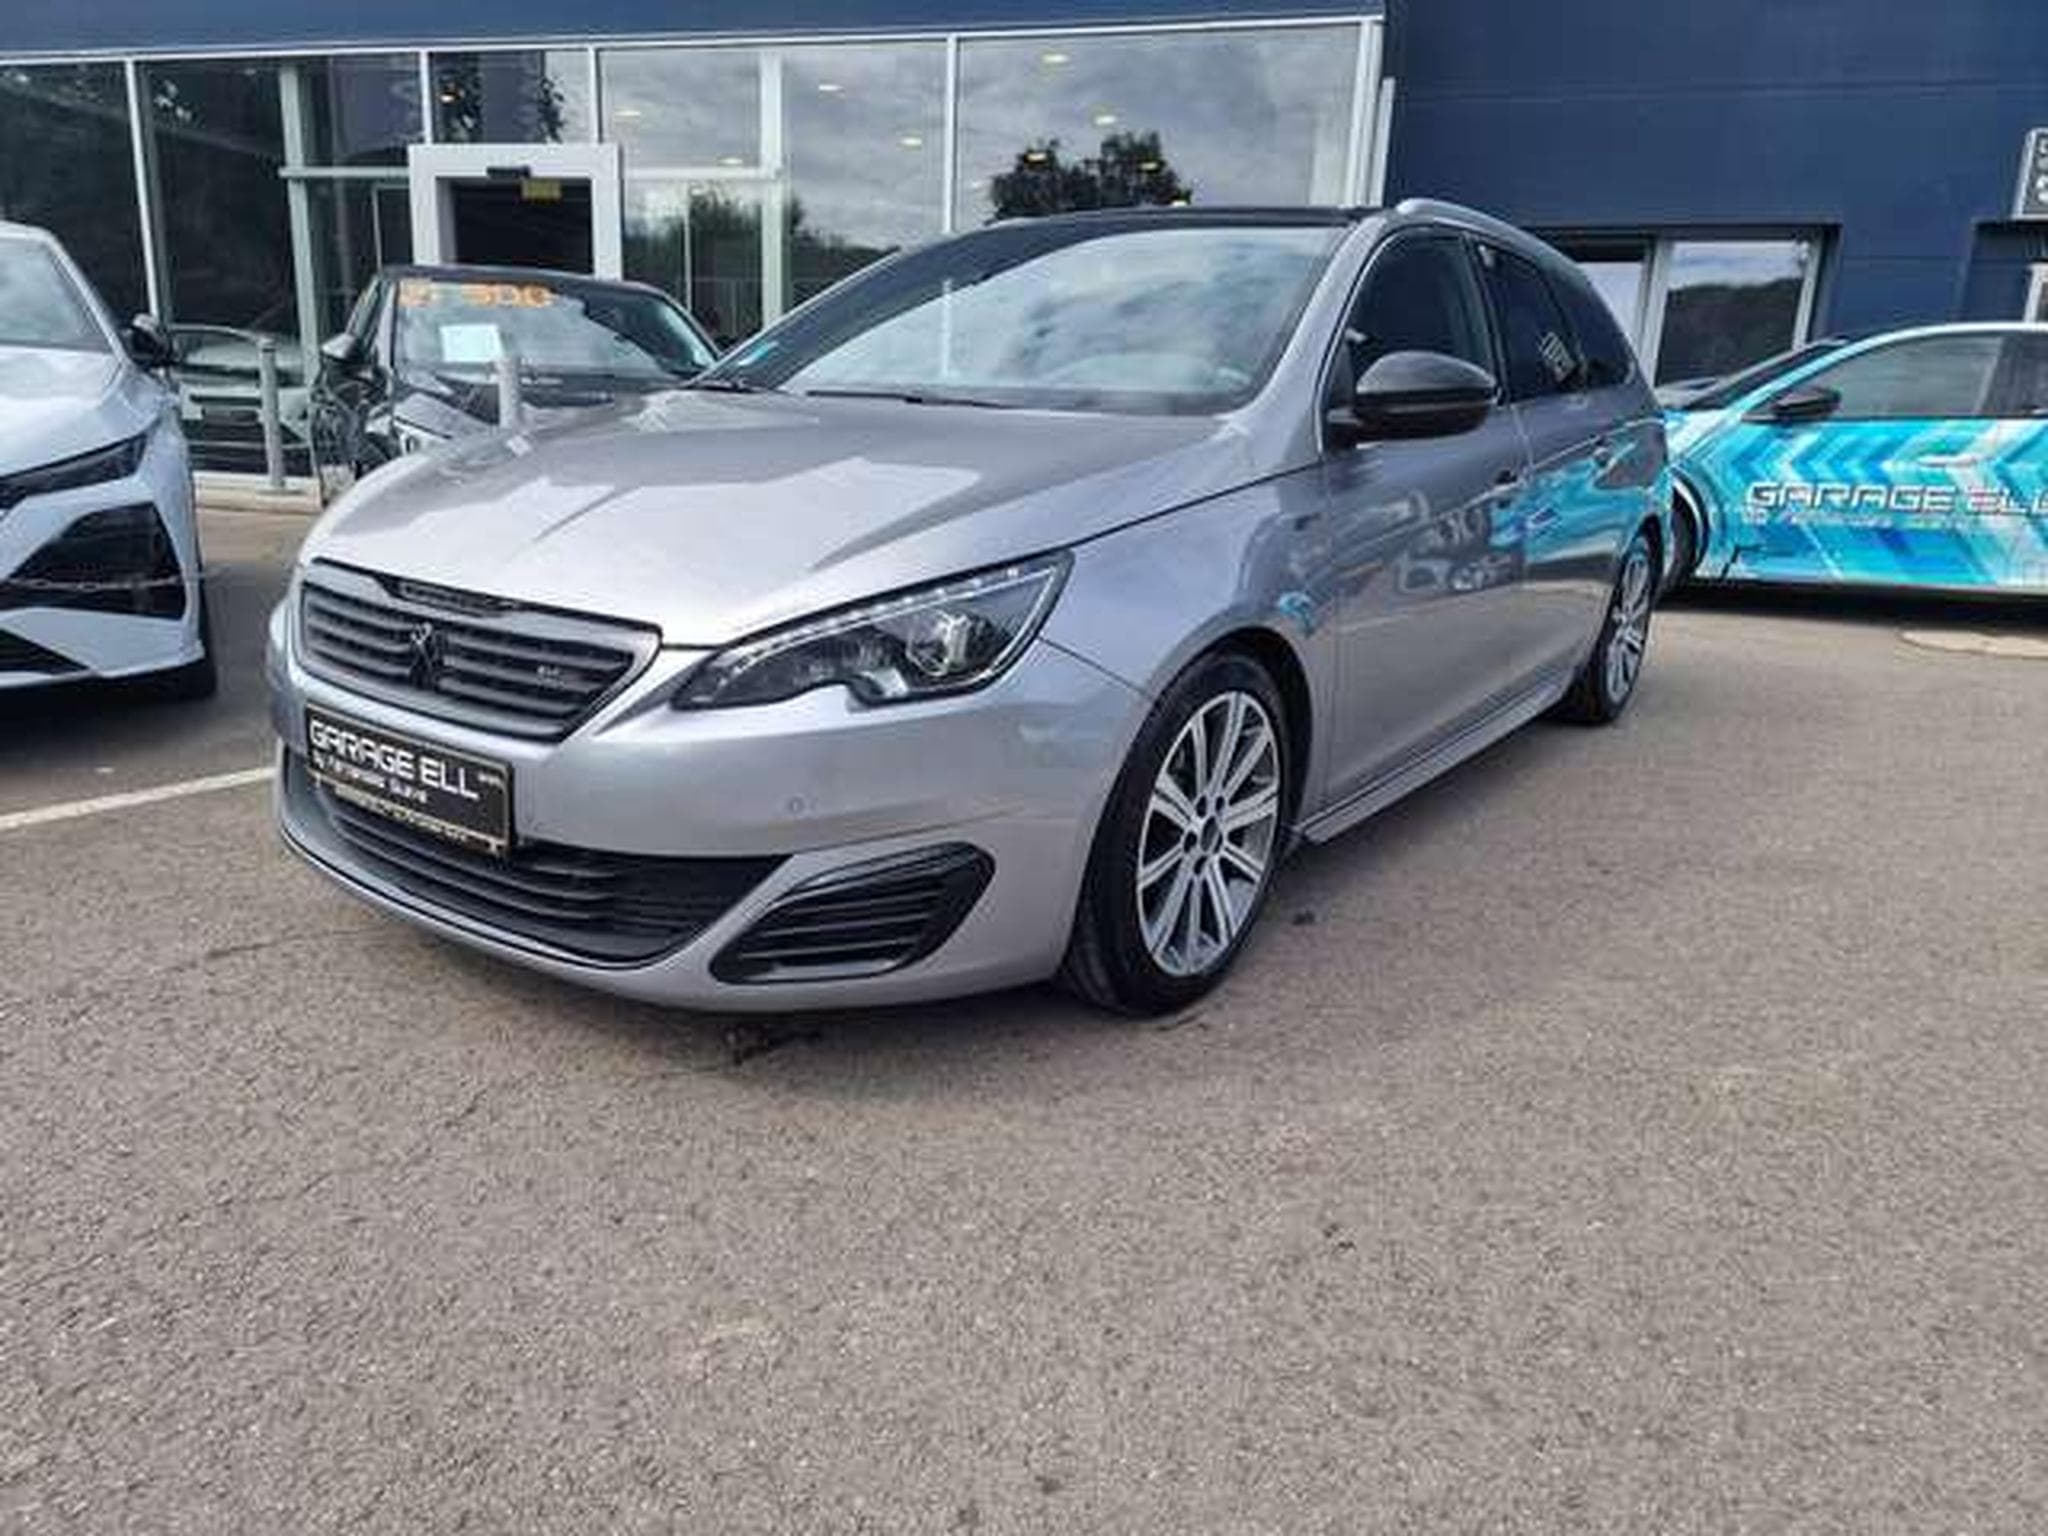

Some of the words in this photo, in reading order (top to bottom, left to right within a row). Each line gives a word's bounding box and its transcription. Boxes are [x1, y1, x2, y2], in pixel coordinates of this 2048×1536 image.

[1747, 481, 1956, 514] GARAGE
[309, 719, 415, 781] GARAGE
[420, 756, 479, 800] ELL
